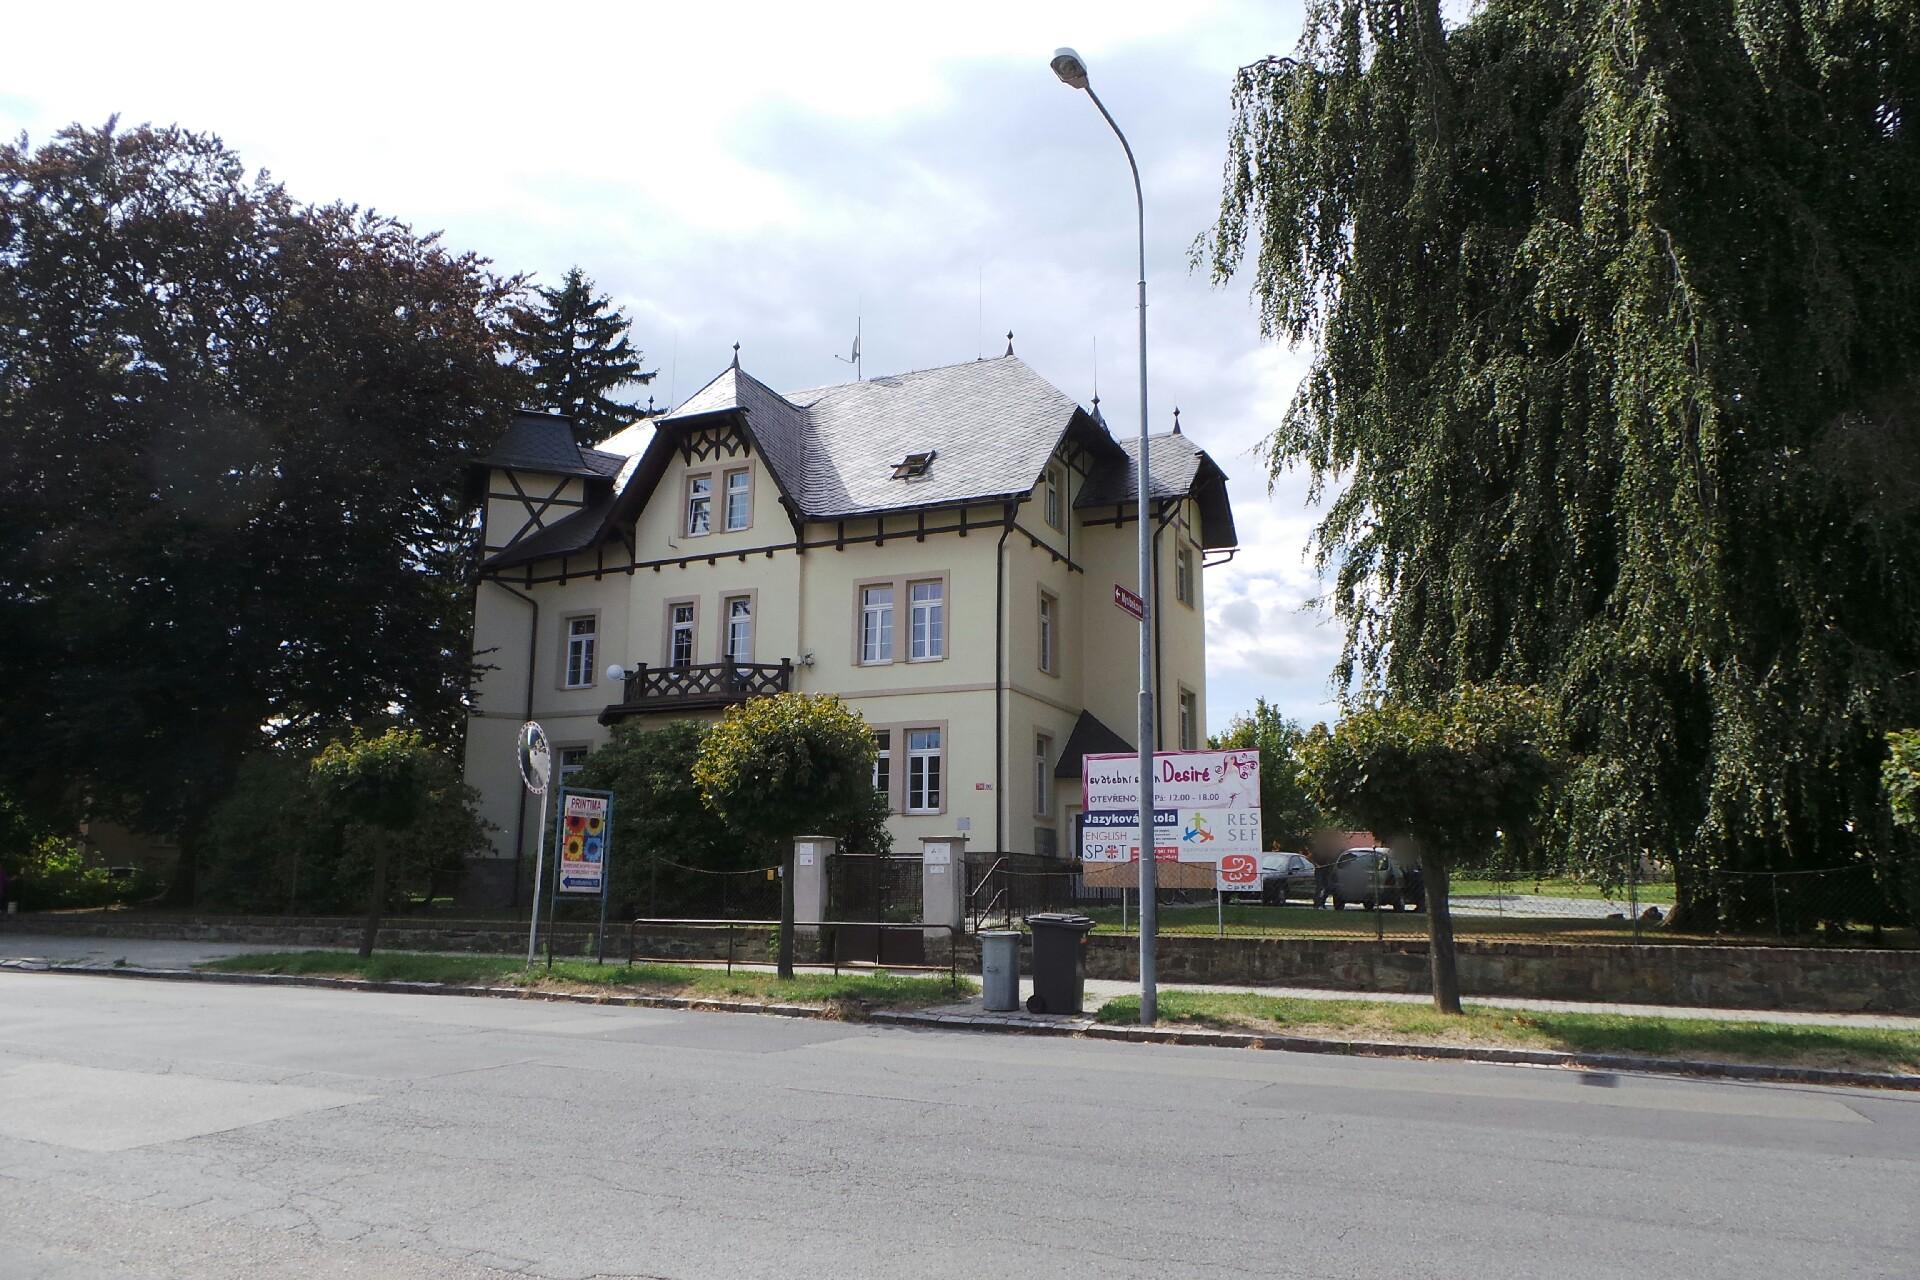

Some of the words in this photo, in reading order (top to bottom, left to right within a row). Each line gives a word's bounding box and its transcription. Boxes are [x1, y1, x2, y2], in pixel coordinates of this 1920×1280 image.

[1163, 760, 1210, 782] Desiré
[1169, 793, 1190, 801] 12.00
[1198, 793, 1220, 801] 18.00
[571, 798, 602, 810] PRINTIMA
[1227, 813, 1259, 826] RES
[1085, 831, 1127, 841] ENGLISH
[1228, 828, 1257, 842] SEF
